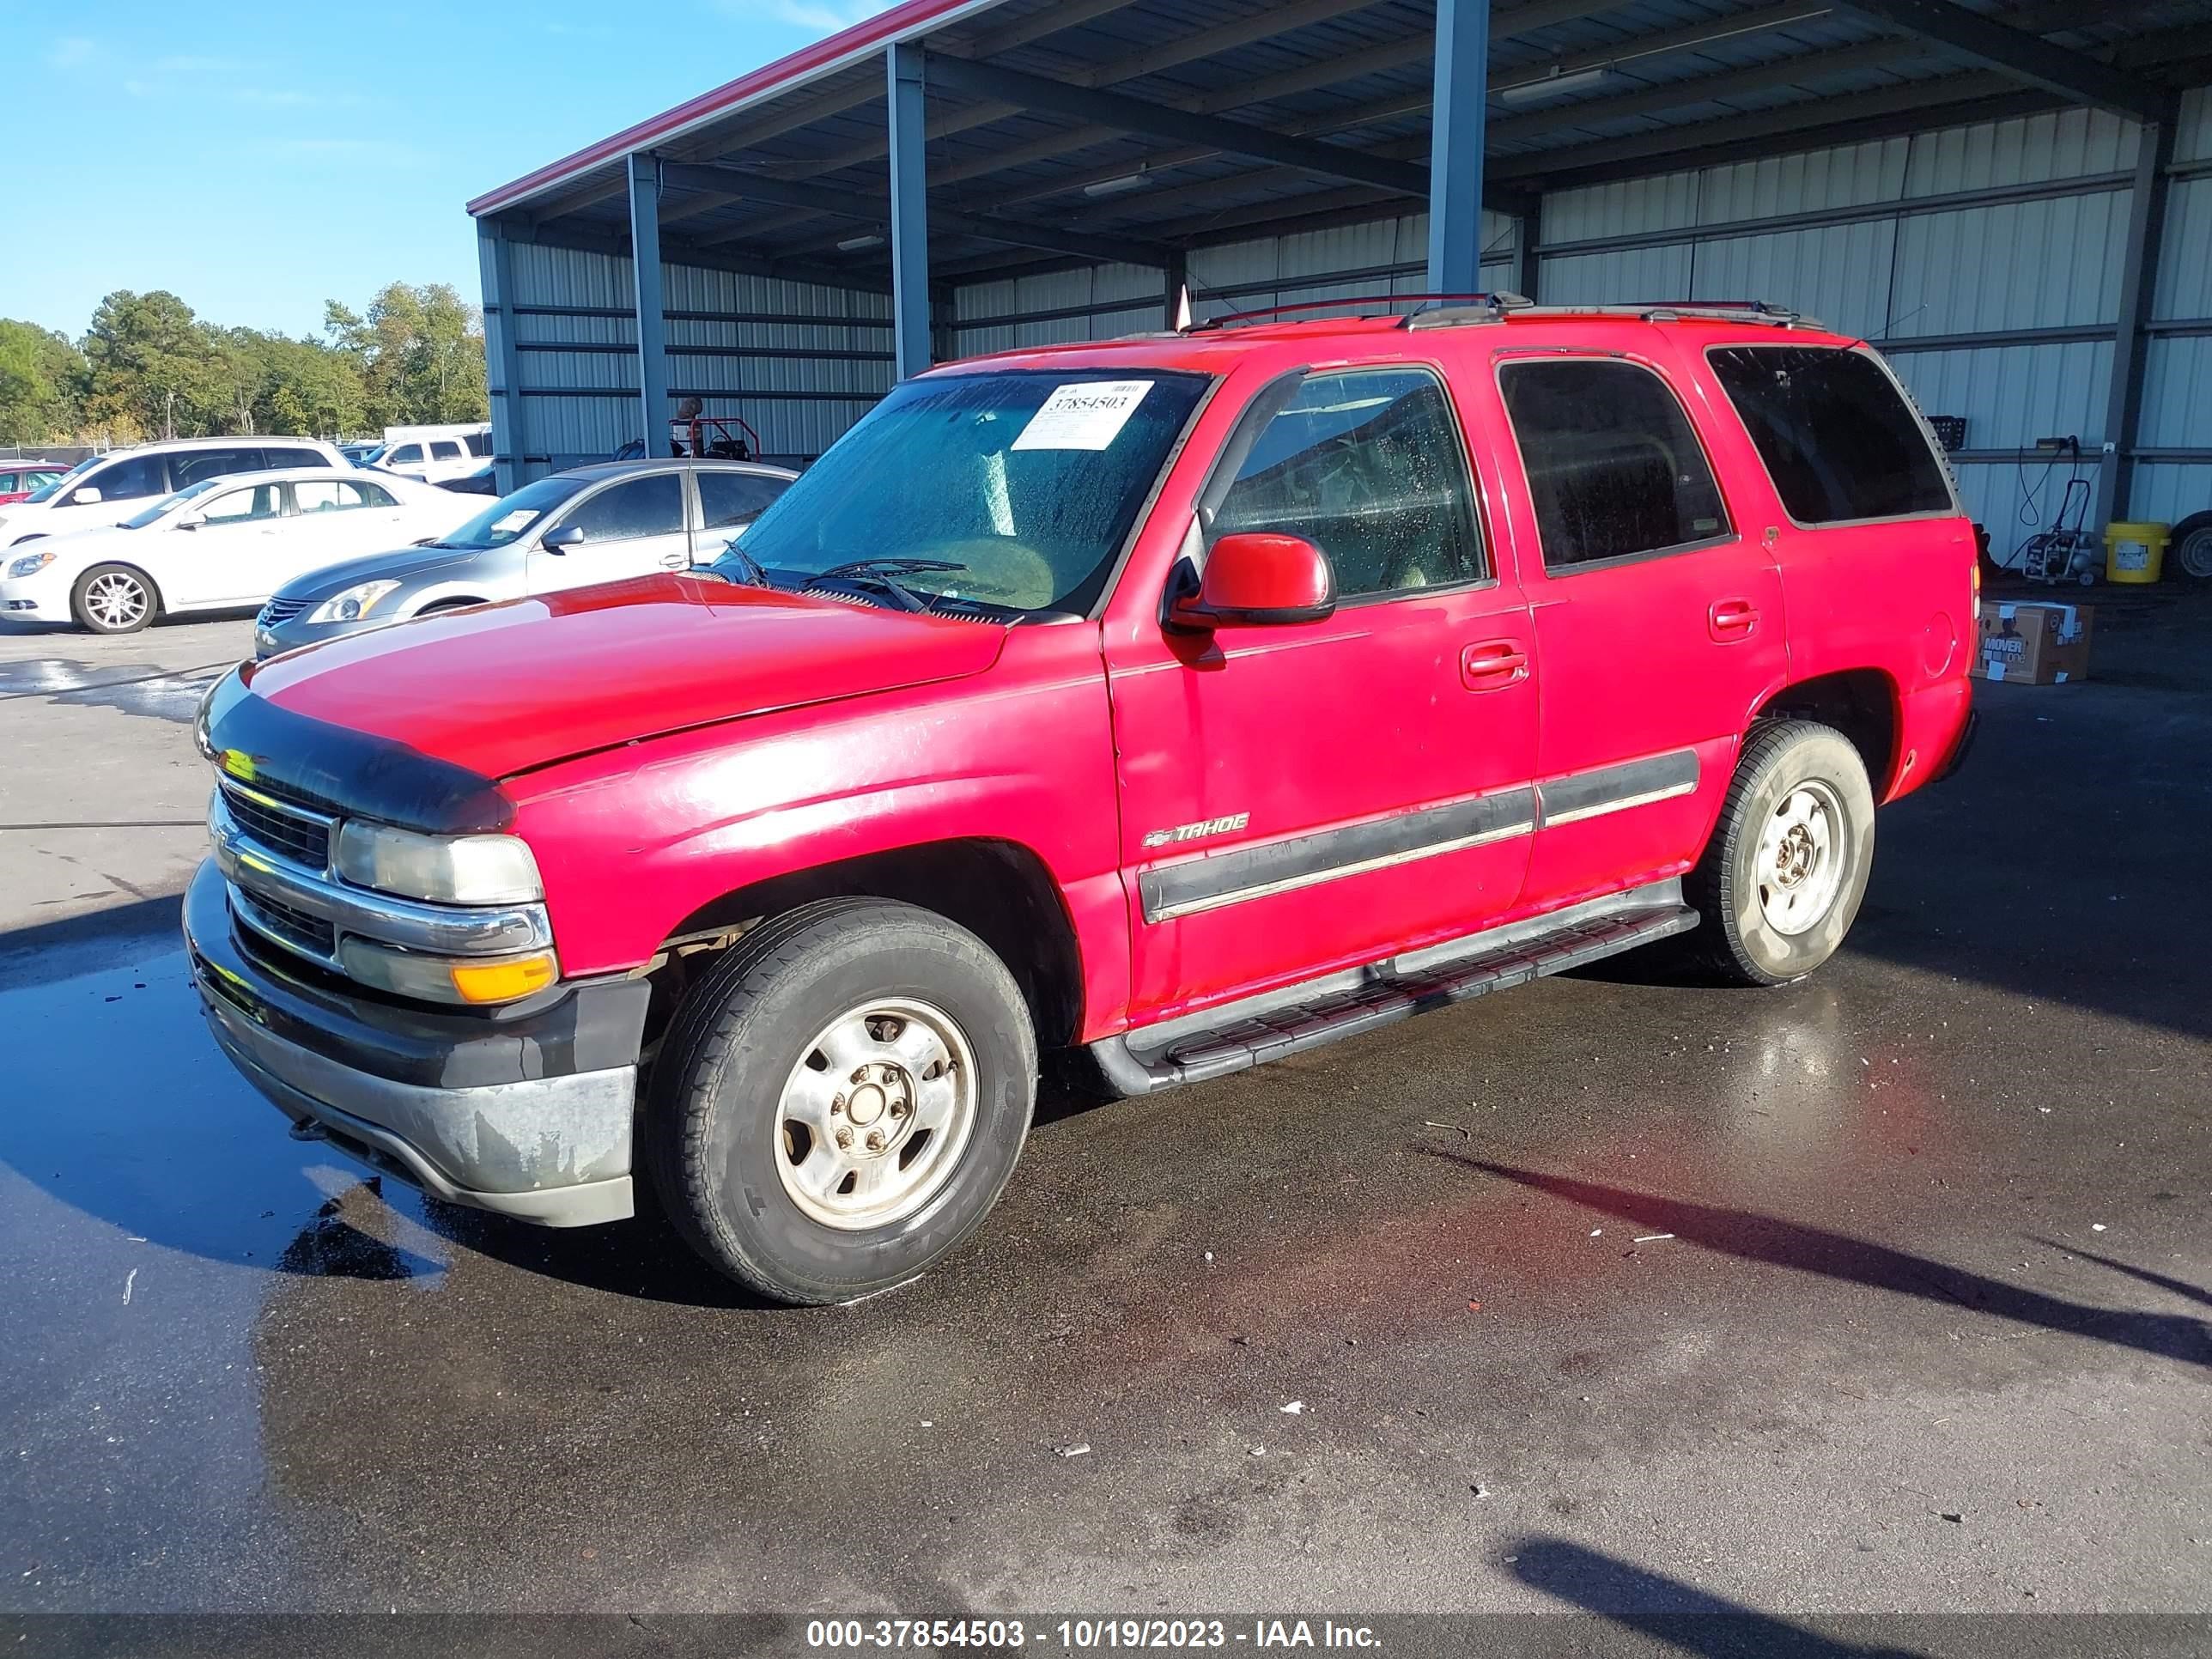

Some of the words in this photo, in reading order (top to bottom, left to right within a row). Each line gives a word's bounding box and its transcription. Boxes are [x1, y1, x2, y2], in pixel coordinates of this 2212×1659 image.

[1049, 396, 1127, 410] 37854503
[1984, 638, 2022, 653] MOVER
[2008, 653, 2027, 664] one
[1176, 812, 1249, 841] TAHOE
